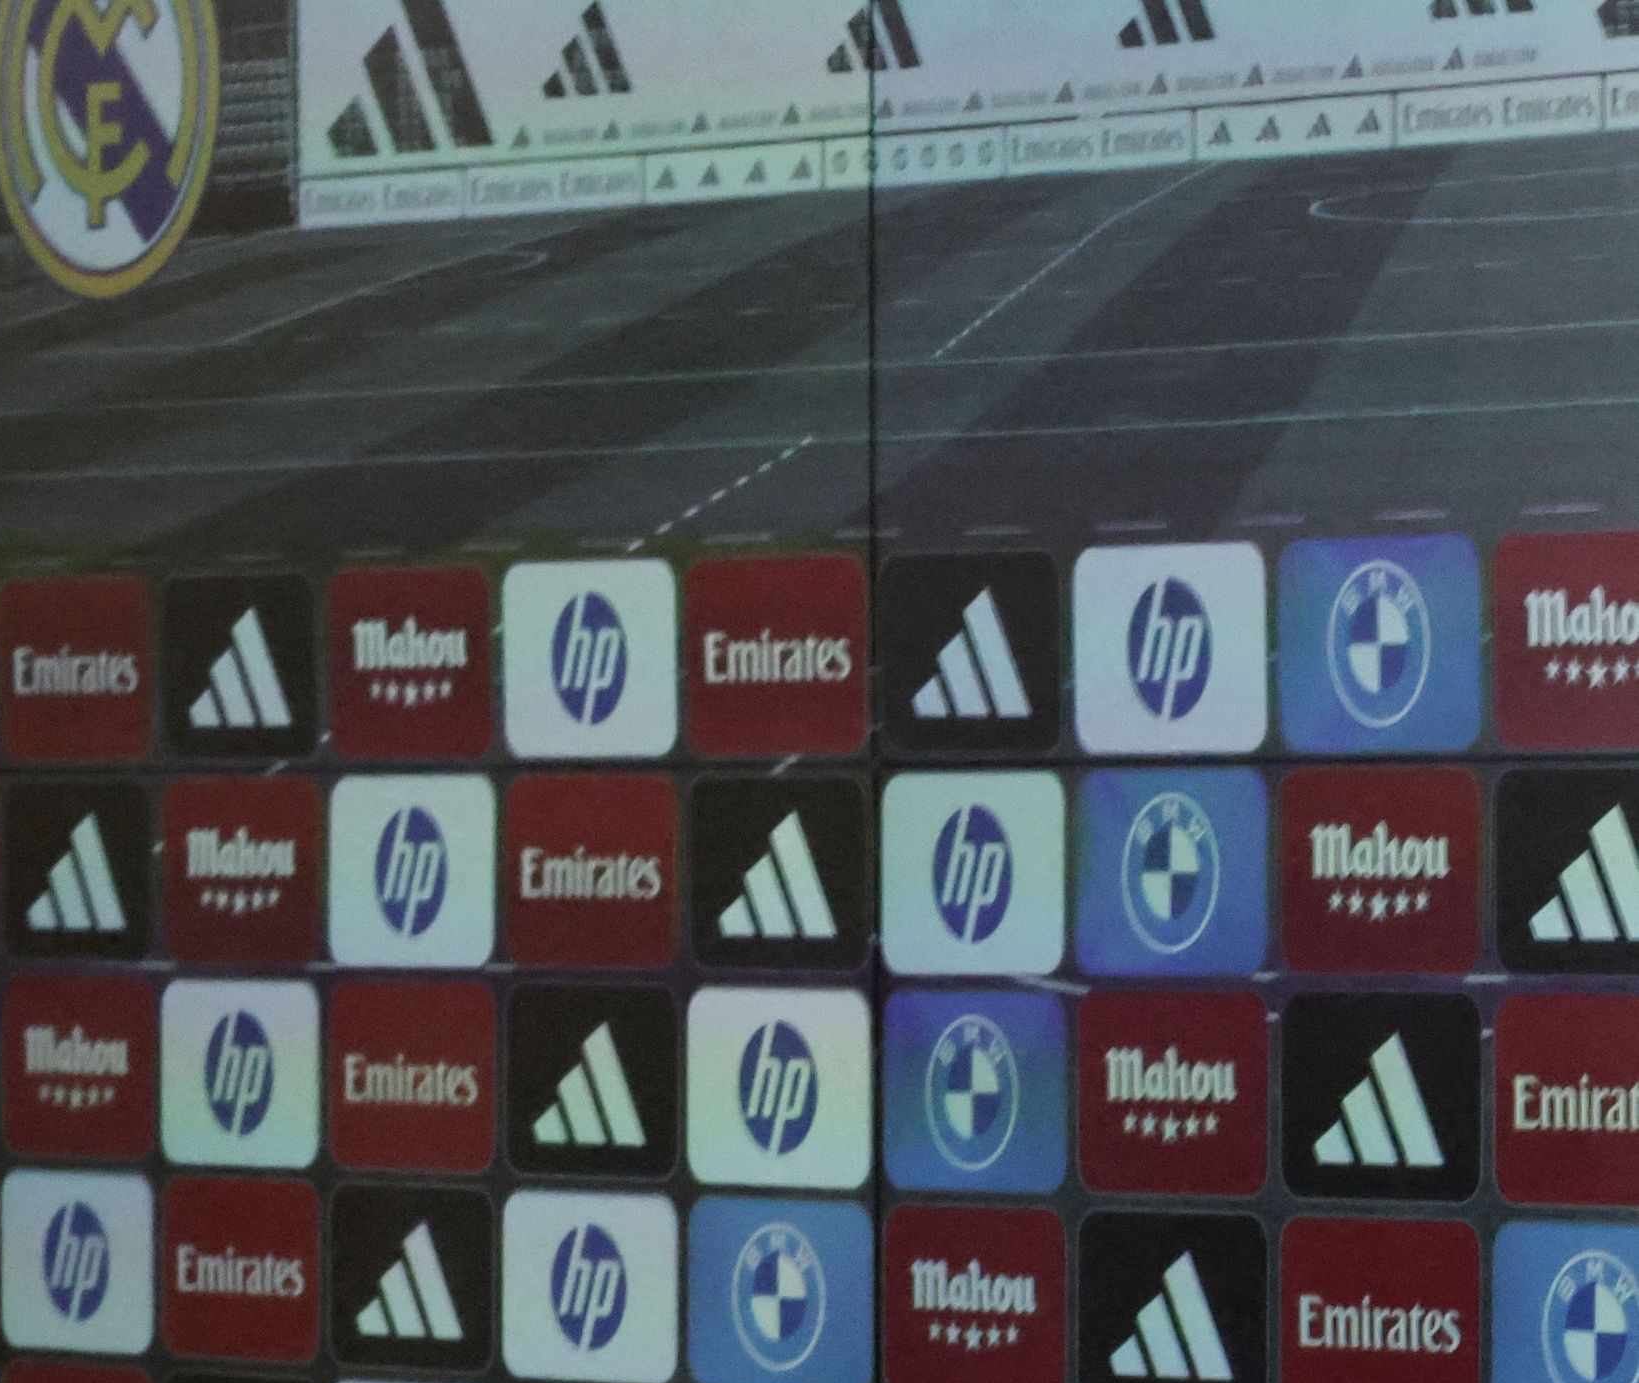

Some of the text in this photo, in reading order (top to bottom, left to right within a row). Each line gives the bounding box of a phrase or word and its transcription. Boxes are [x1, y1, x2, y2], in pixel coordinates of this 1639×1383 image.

[1523, 584, 1639, 648] Maho
[11, 645, 140, 697] Emirates
[558, 593, 622, 724] hp
[702, 628, 854, 685] Emirates
[1135, 579, 1206, 719] hp
[381, 808, 442, 936] hp
[519, 844, 663, 900] Emirates
[939, 806, 1007, 942] hp
[1308, 820, 1451, 880] Mahou
[210, 1011, 268, 1136] hp
[342, 1052, 480, 1107] Emirates
[745, 1022, 813, 1155] hp
[1103, 1045, 1238, 1104] Mahou
[1511, 1073, 1639, 1133] Emirat
[48, 1202, 105, 1321] hp
[174, 1243, 307, 1299] Emirates
[557, 1225, 622, 1350] hp
[909, 1258, 1038, 1316] Mahou
[1296, 1292, 1463, 1355] Emirates
